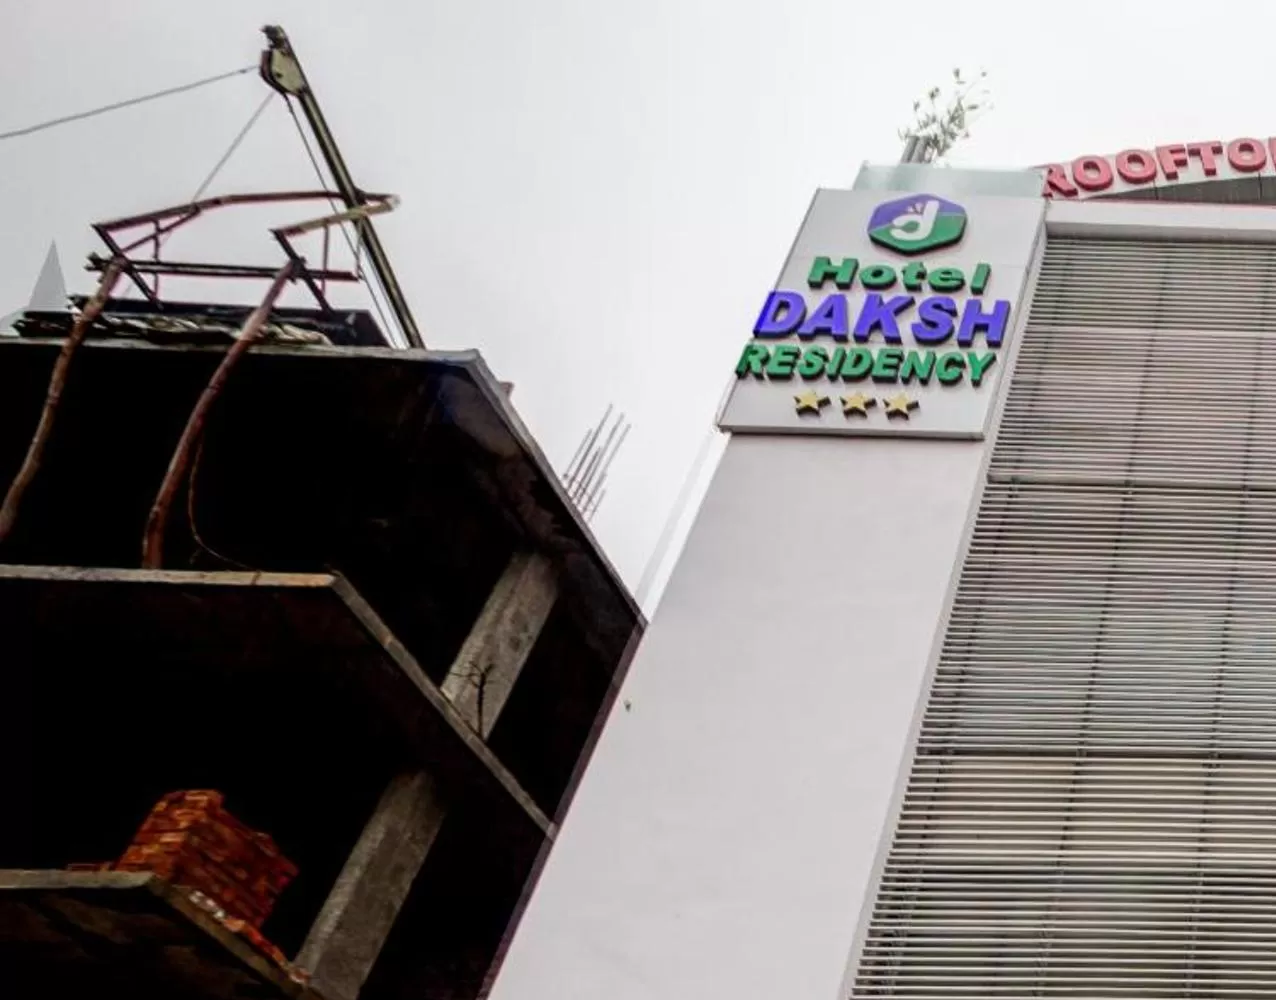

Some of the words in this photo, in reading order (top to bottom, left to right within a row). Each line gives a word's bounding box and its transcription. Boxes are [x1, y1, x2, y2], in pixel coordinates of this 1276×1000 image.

[807, 256, 991, 294] Hotel
[753, 290, 1011, 348] DAKSH
[735, 344, 996, 386] RESIDENCY
